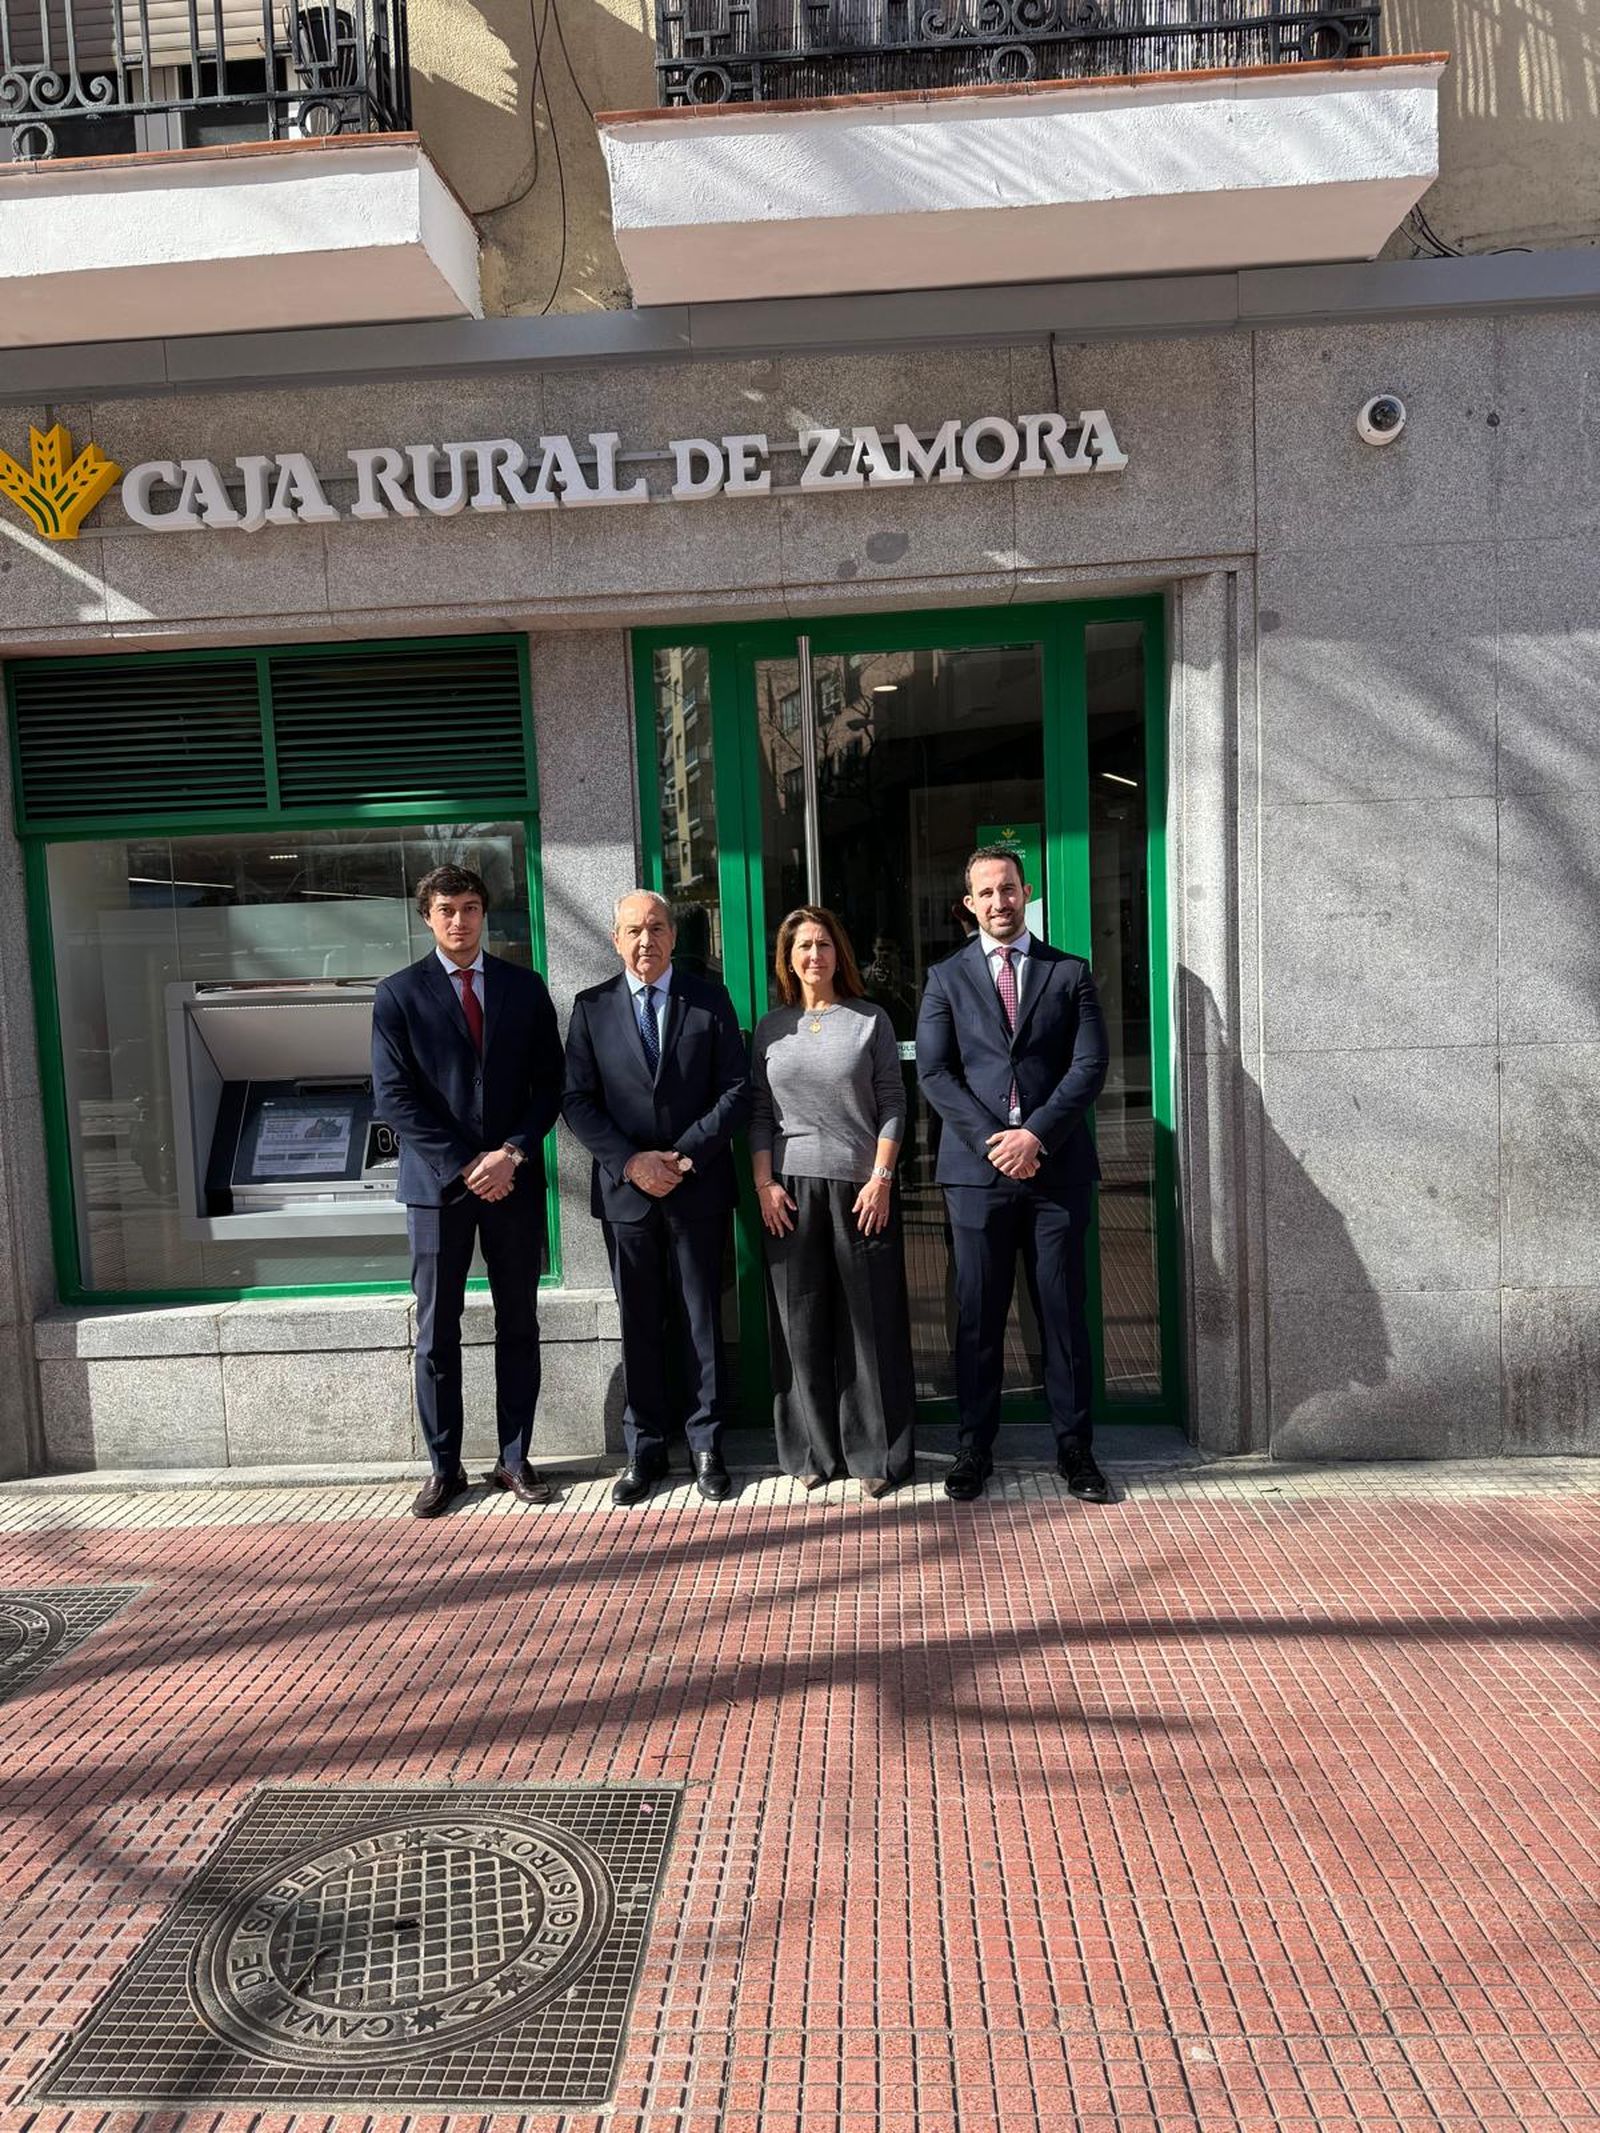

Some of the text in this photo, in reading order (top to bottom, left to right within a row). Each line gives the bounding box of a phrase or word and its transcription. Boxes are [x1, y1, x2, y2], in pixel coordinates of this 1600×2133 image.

[121, 410, 1129, 533] CAJA RURAL DE ZAMORA
[231, 1838, 395, 2039] CANAL DE ISABEL II
[511, 1840, 579, 1969] REGISTRO
